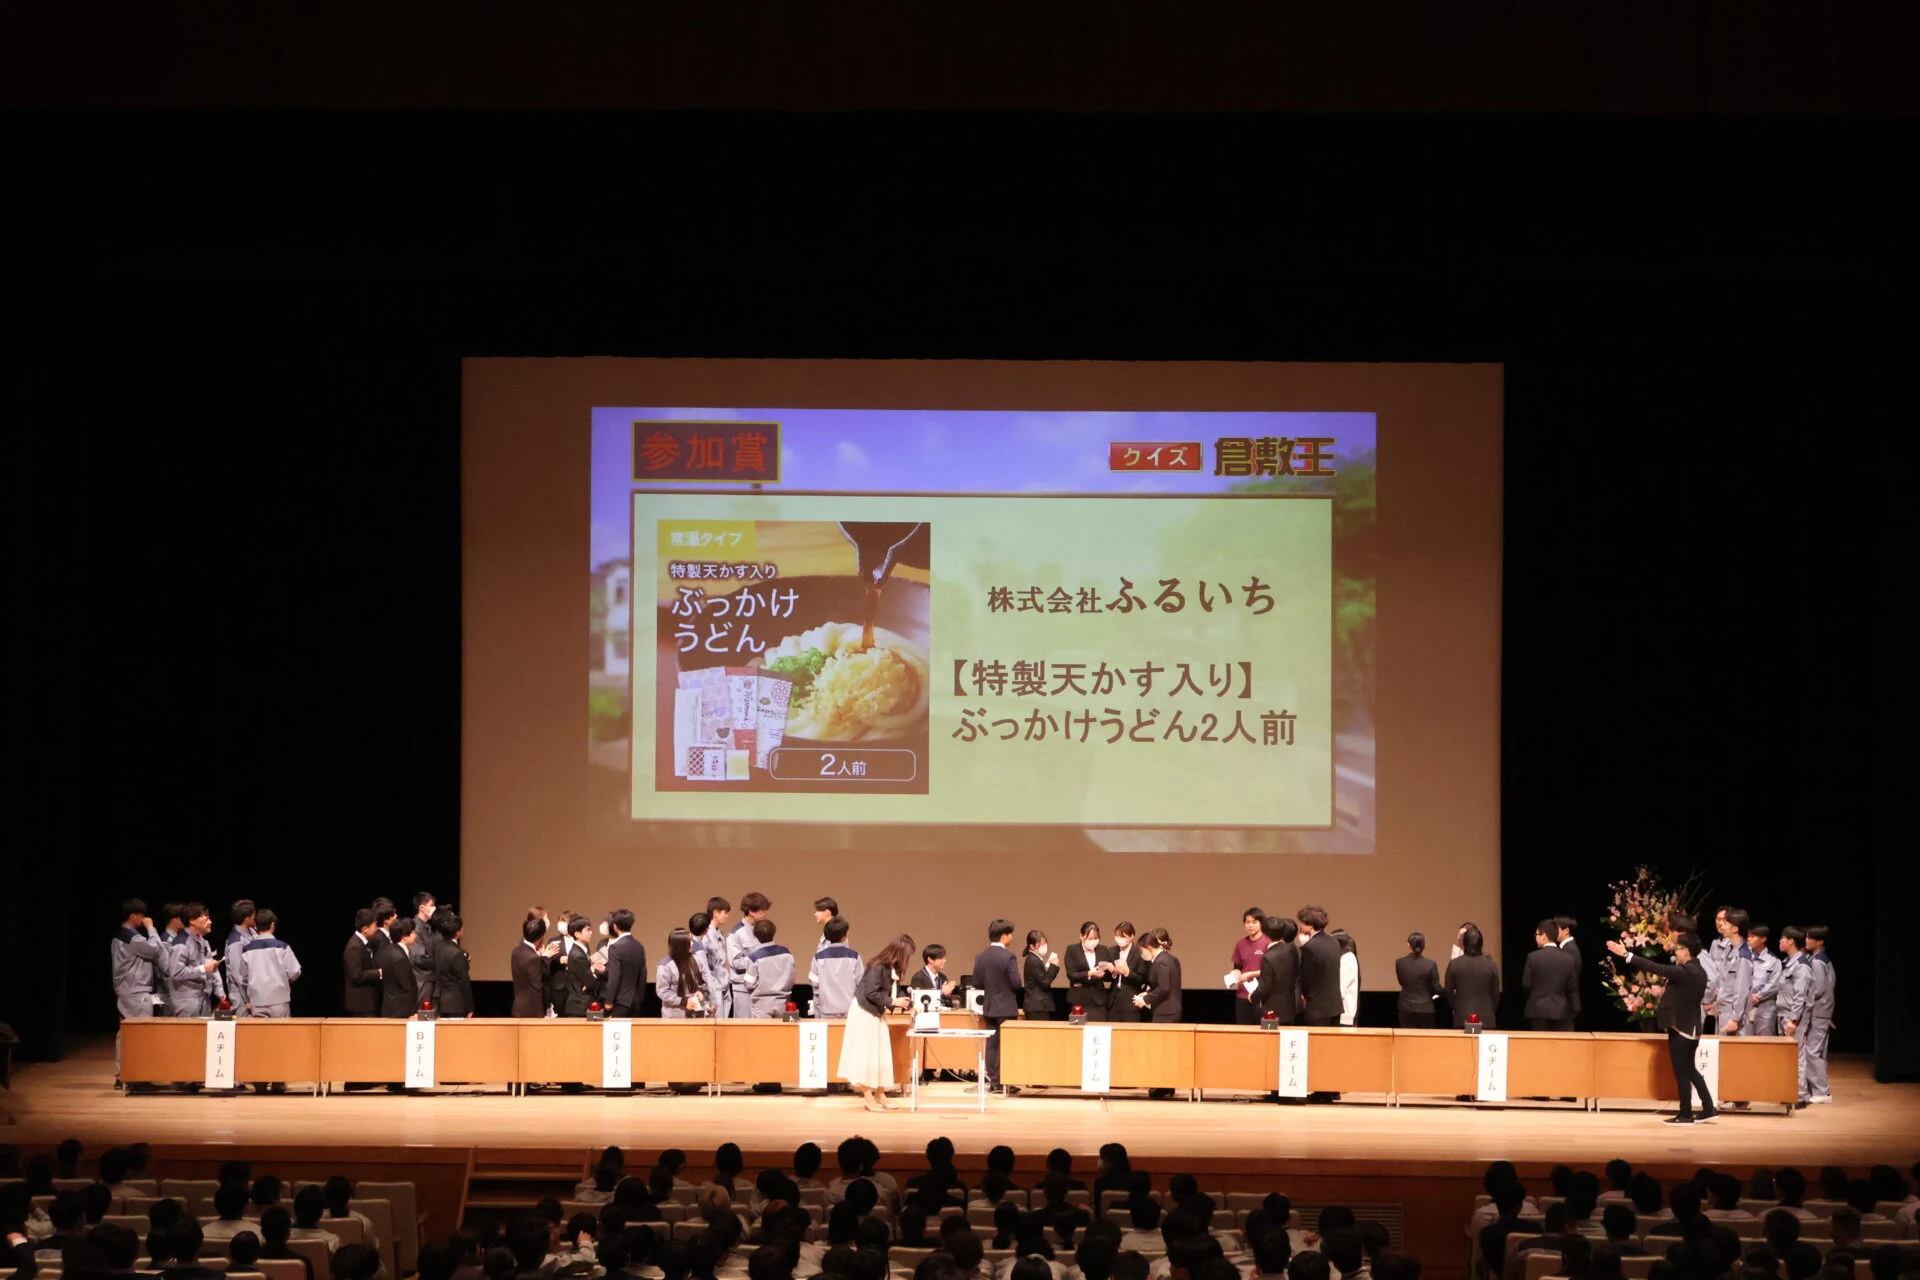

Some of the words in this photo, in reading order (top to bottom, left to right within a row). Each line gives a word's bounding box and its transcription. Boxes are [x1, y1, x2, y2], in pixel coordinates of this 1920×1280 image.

[641, 431, 769, 473] 参加賞
[1123, 447, 1188, 467] クイズ
[1214, 437, 1336, 477] 倉敷王
[670, 563, 776, 579] 特製天かす入り
[671, 587, 800, 618] ぶっかけ
[987, 576, 1276, 615] 株式会社ふるいち
[674, 621, 766, 653] うどん
[952, 708, 1297, 746] ぶっかけうどん2人前
[820, 753, 867, 776] 2人前
[215, 1031, 226, 1078] Aチーム
[415, 1031, 425, 1078] Bチーム
[612, 1031, 622, 1078] Cチーム
[808, 1032, 818, 1078] Dチーム
[1288, 1040, 1298, 1087] Fチーム
[1487, 1044, 1498, 1091] Gチーム
